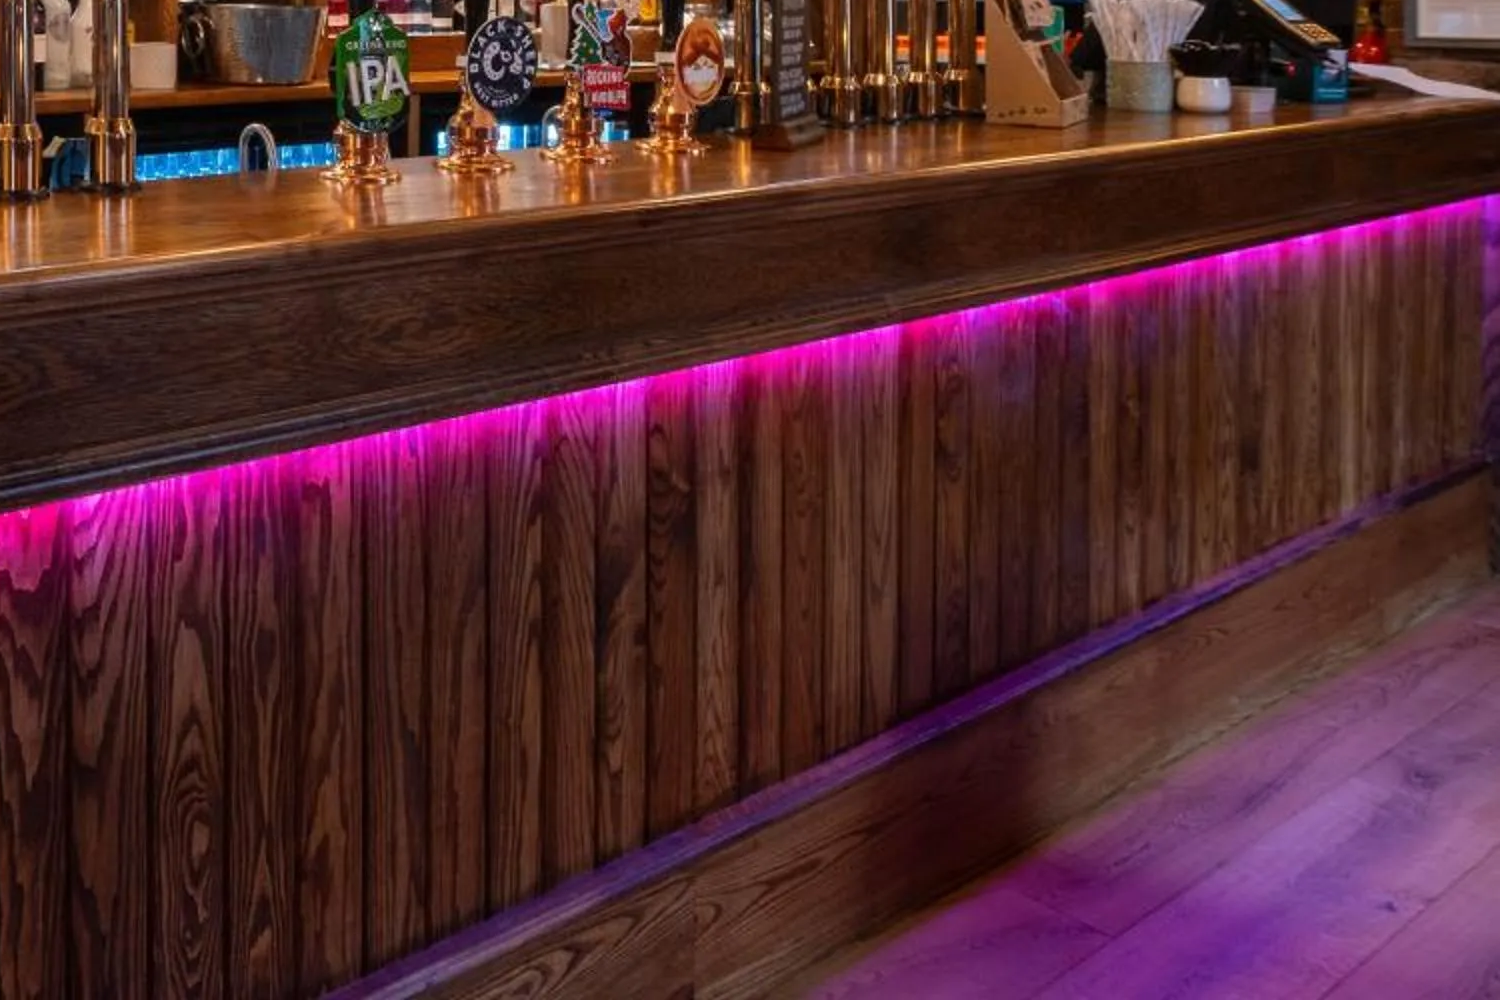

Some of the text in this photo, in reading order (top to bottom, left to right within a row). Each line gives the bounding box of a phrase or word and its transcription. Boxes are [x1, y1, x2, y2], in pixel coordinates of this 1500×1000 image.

[345, 54, 411, 107] IPA
[468, 19, 536, 90] BLACK SHEEP
